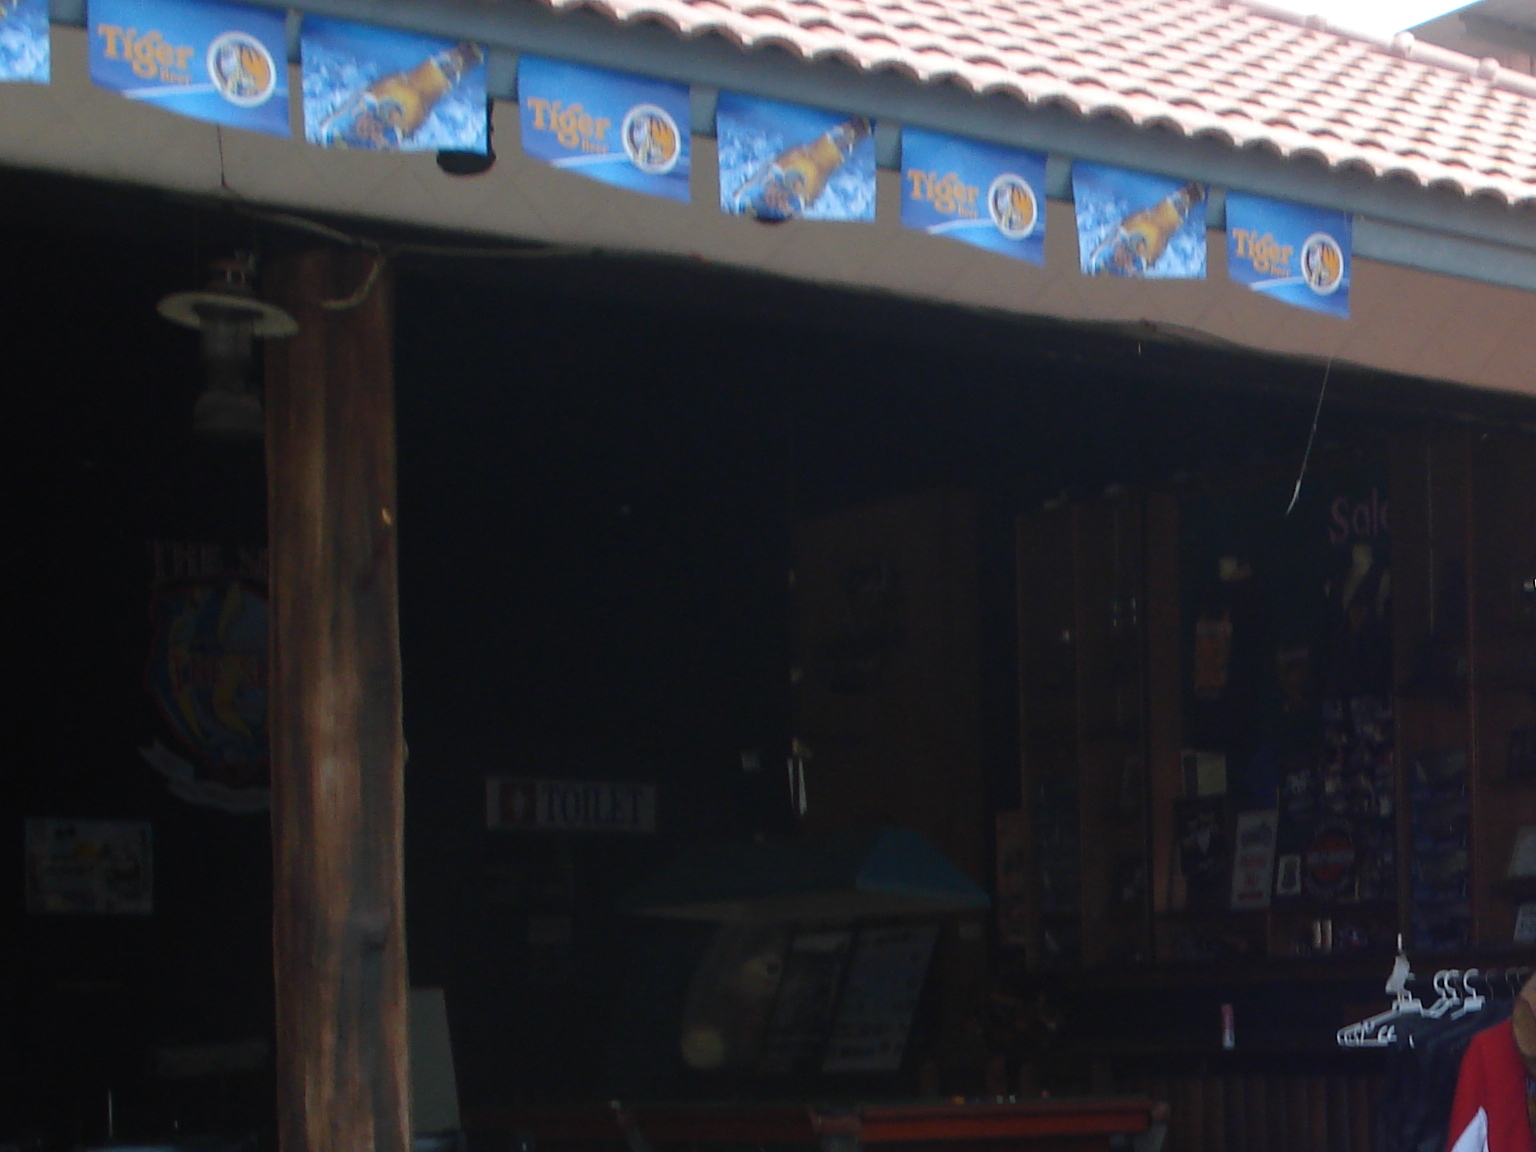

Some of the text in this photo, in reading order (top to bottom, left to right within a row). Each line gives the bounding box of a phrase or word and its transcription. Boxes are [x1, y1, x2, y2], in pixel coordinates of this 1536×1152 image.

[98, 24, 193, 78] Tiger
[528, 97, 611, 149] Tiger
[907, 168, 979, 214] Tiger
[1233, 228, 1293, 273] Tiger
[542, 780, 643, 824] TOILET
